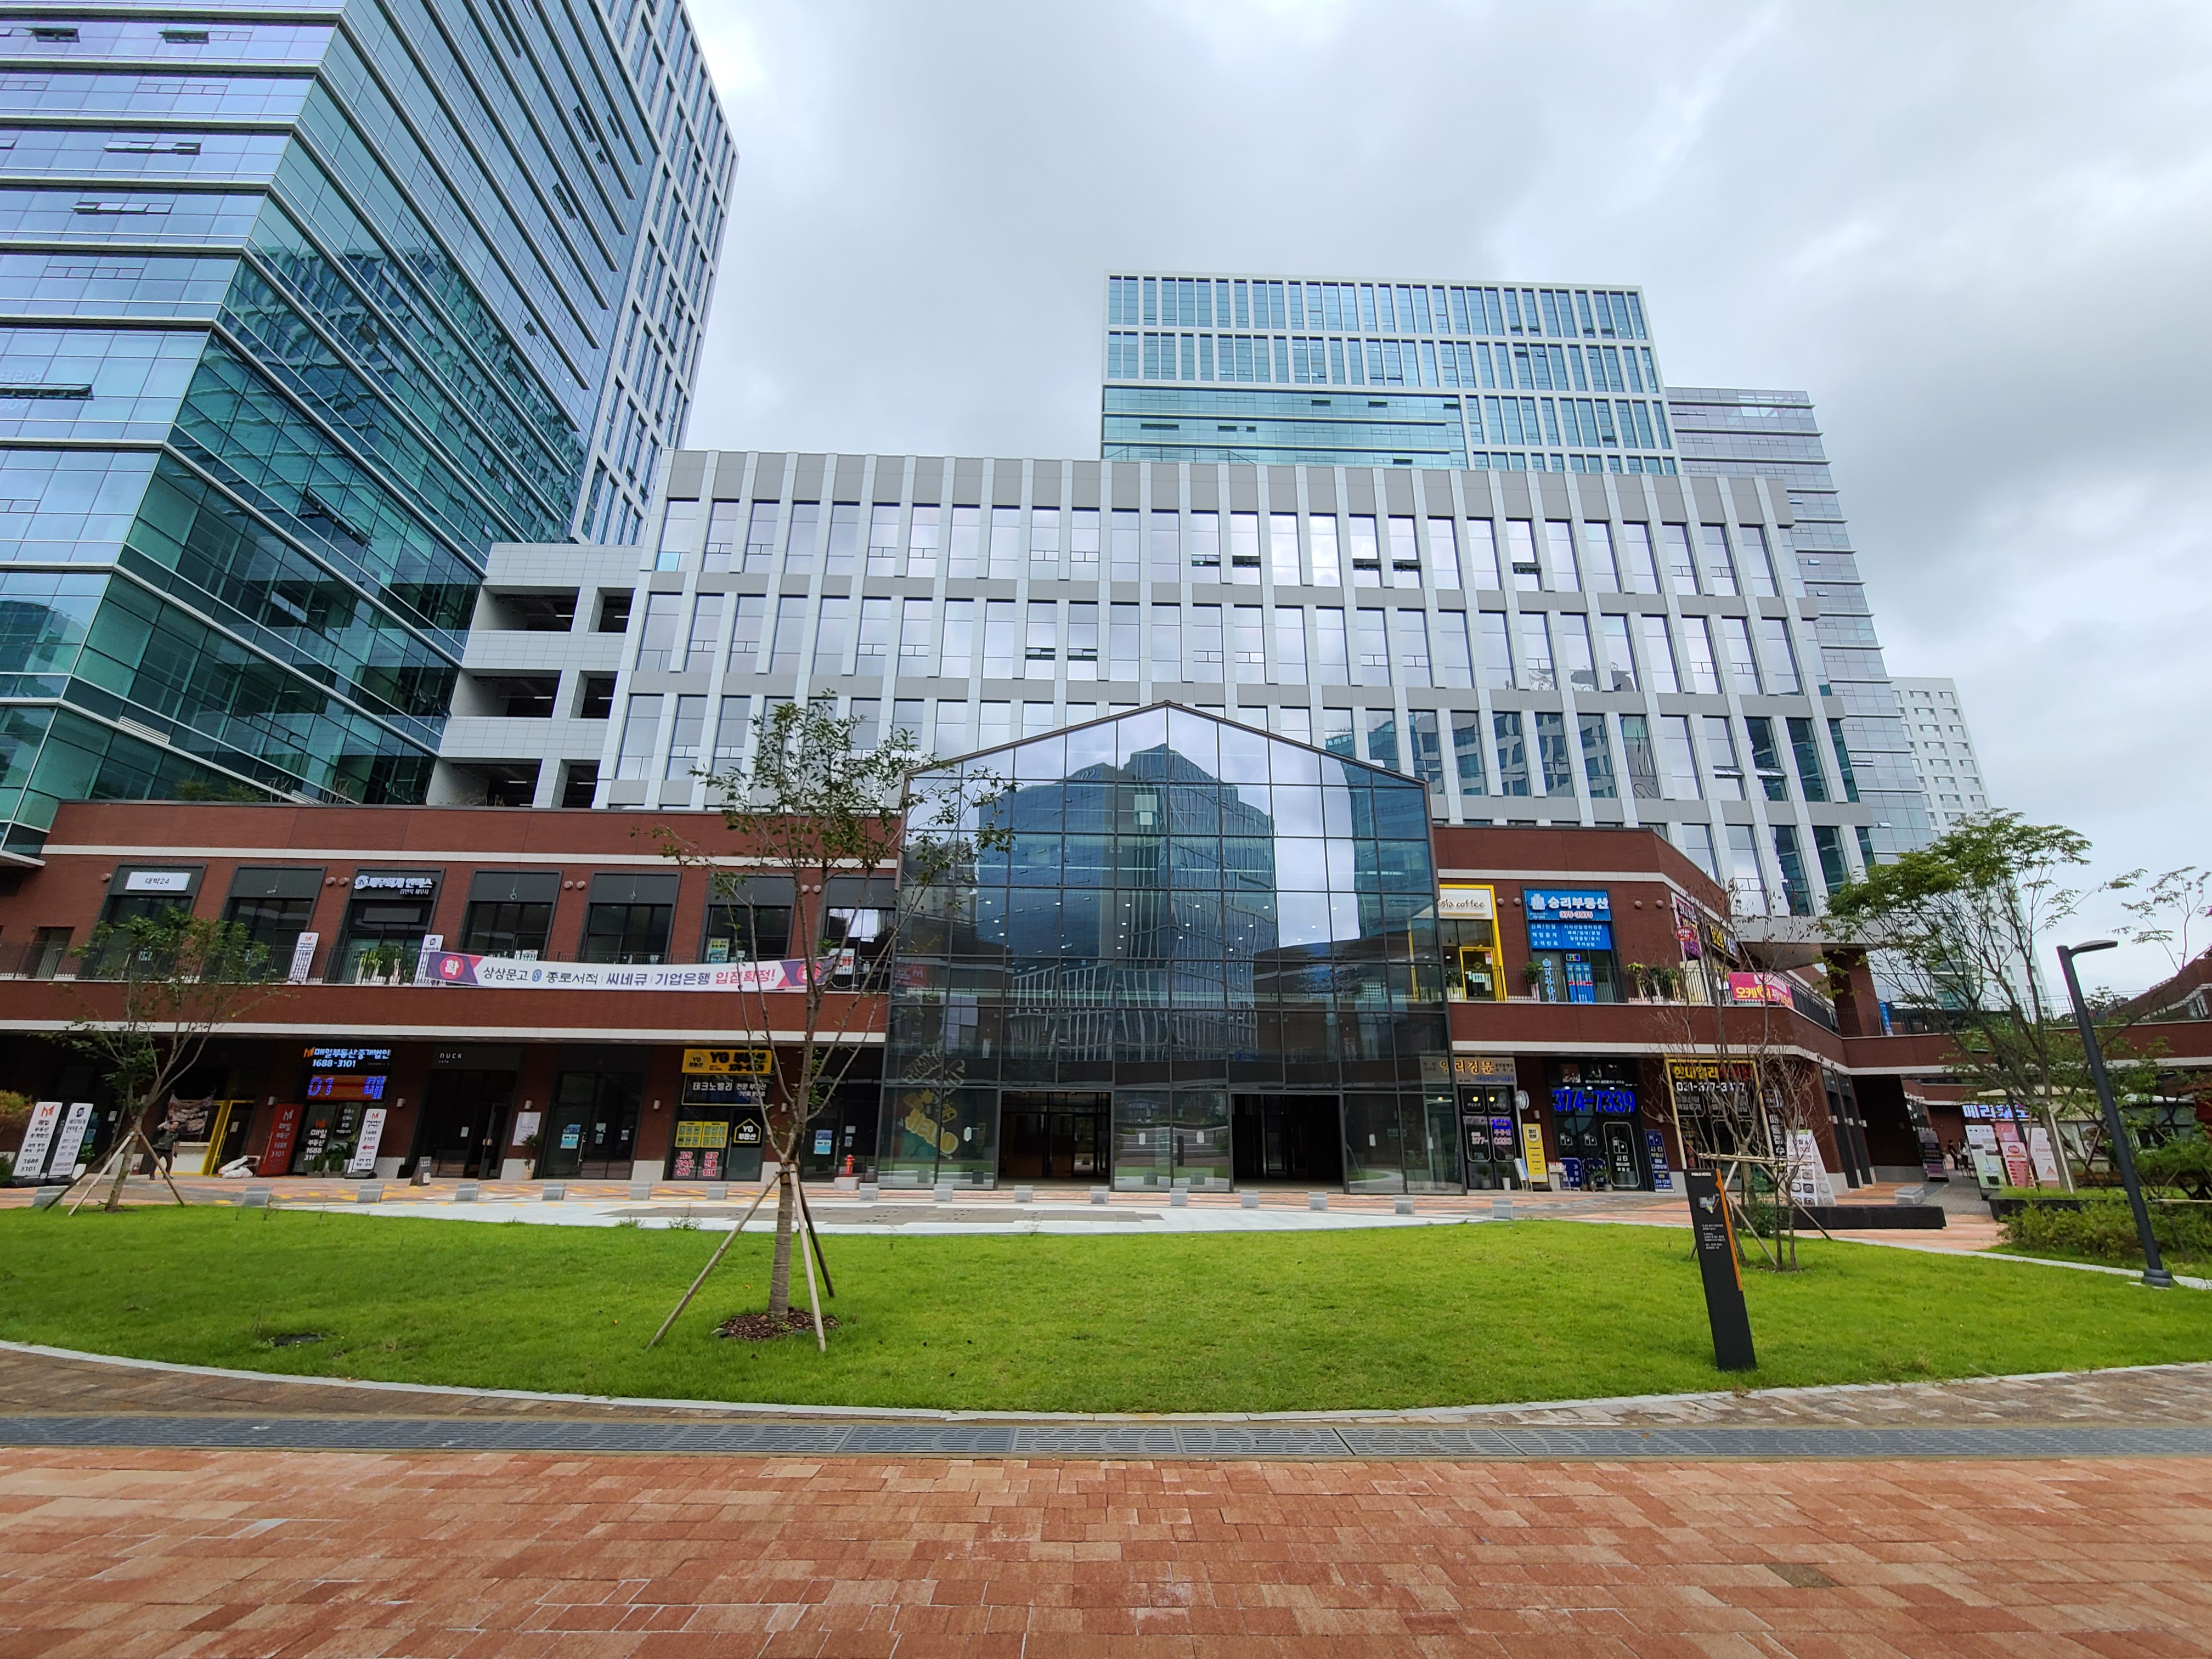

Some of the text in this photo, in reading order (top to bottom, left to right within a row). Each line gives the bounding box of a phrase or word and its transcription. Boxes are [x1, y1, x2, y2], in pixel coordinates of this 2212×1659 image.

[1456, 900, 1485, 909] coffee
[1547, 896, 1609, 910] 승리부동산
[483, 966, 528, 981] 상상문고
[546, 970, 599, 985] 종로서적
[606, 972, 648, 986] 씨네큐
[654, 972, 711, 986] 기업은행
[314, 1048, 391, 1059] 매일부동산중개법인
[709, 1052, 730, 1063] YG
[312, 1059, 357, 1068] 1688-3101
[692, 1081, 733, 1091] 테크노밸리
[1552, 1089, 1636, 1113] 374-7339
[310, 1128, 328, 1139] 매일
[307, 1138, 325, 1147] 부동산
